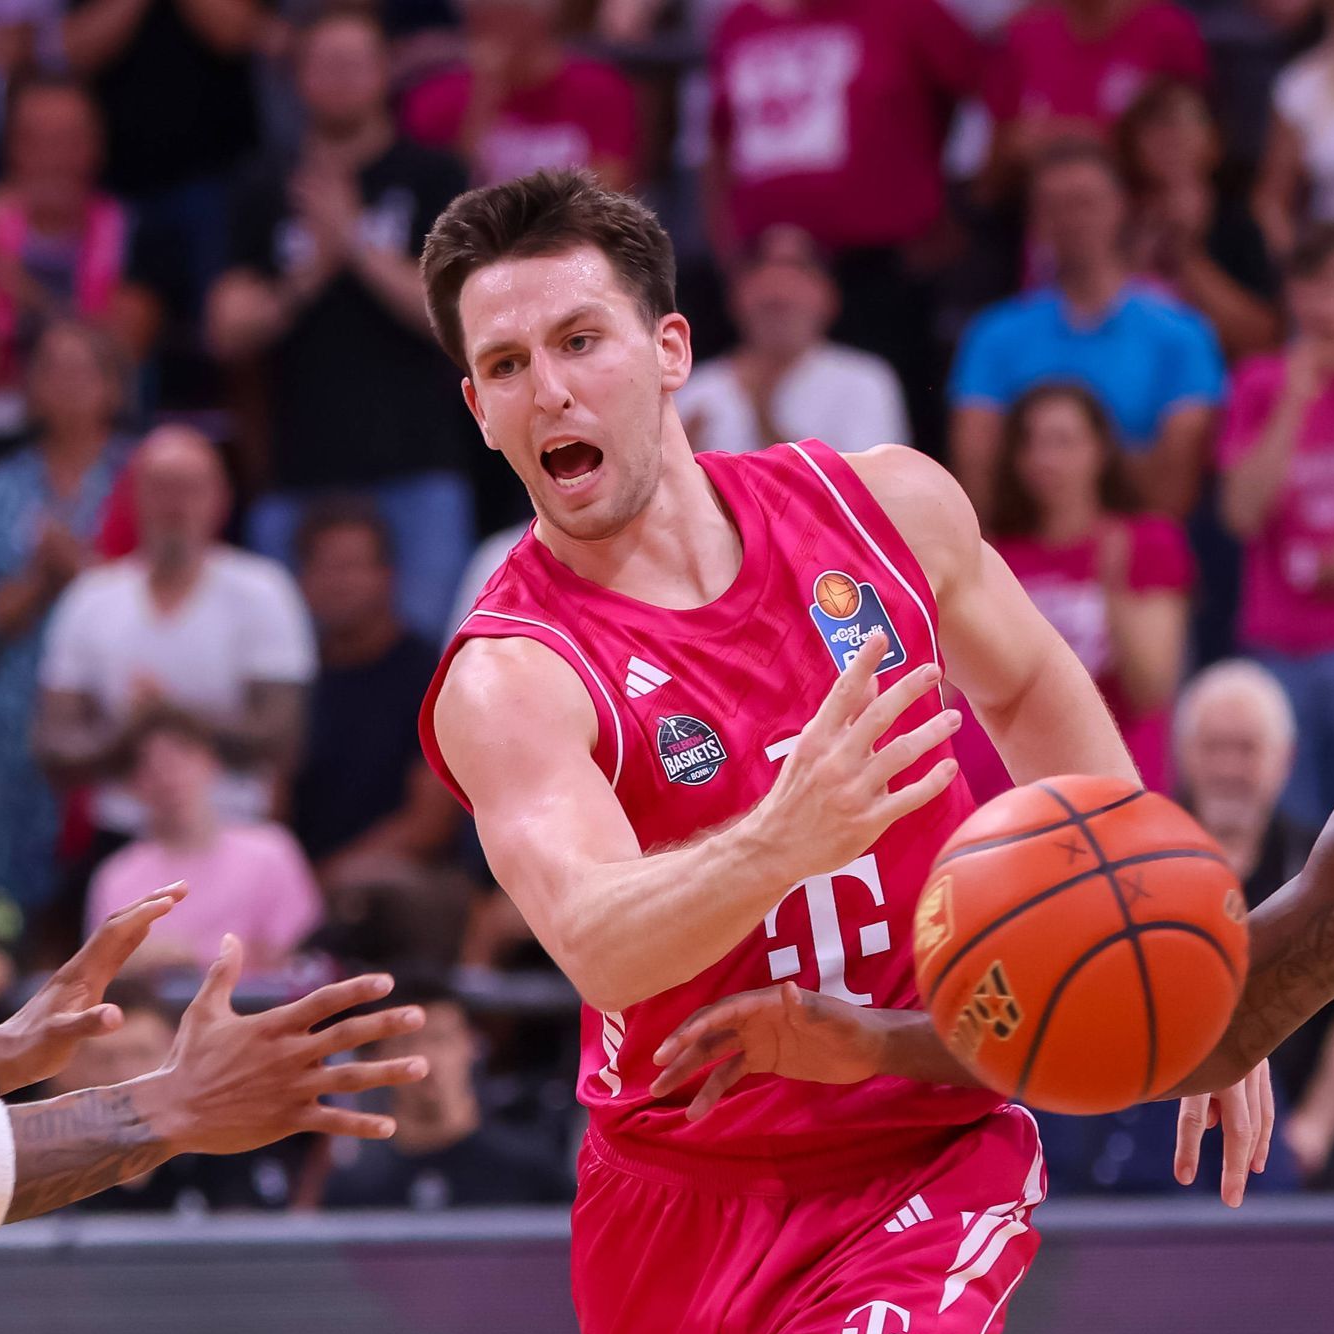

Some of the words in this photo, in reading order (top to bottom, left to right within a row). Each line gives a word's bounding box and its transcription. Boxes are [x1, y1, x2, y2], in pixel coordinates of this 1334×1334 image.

[667, 734, 705, 755] TELEKOM
[664, 739, 721, 776] BASKETS
[690, 767, 710, 781] BONN
